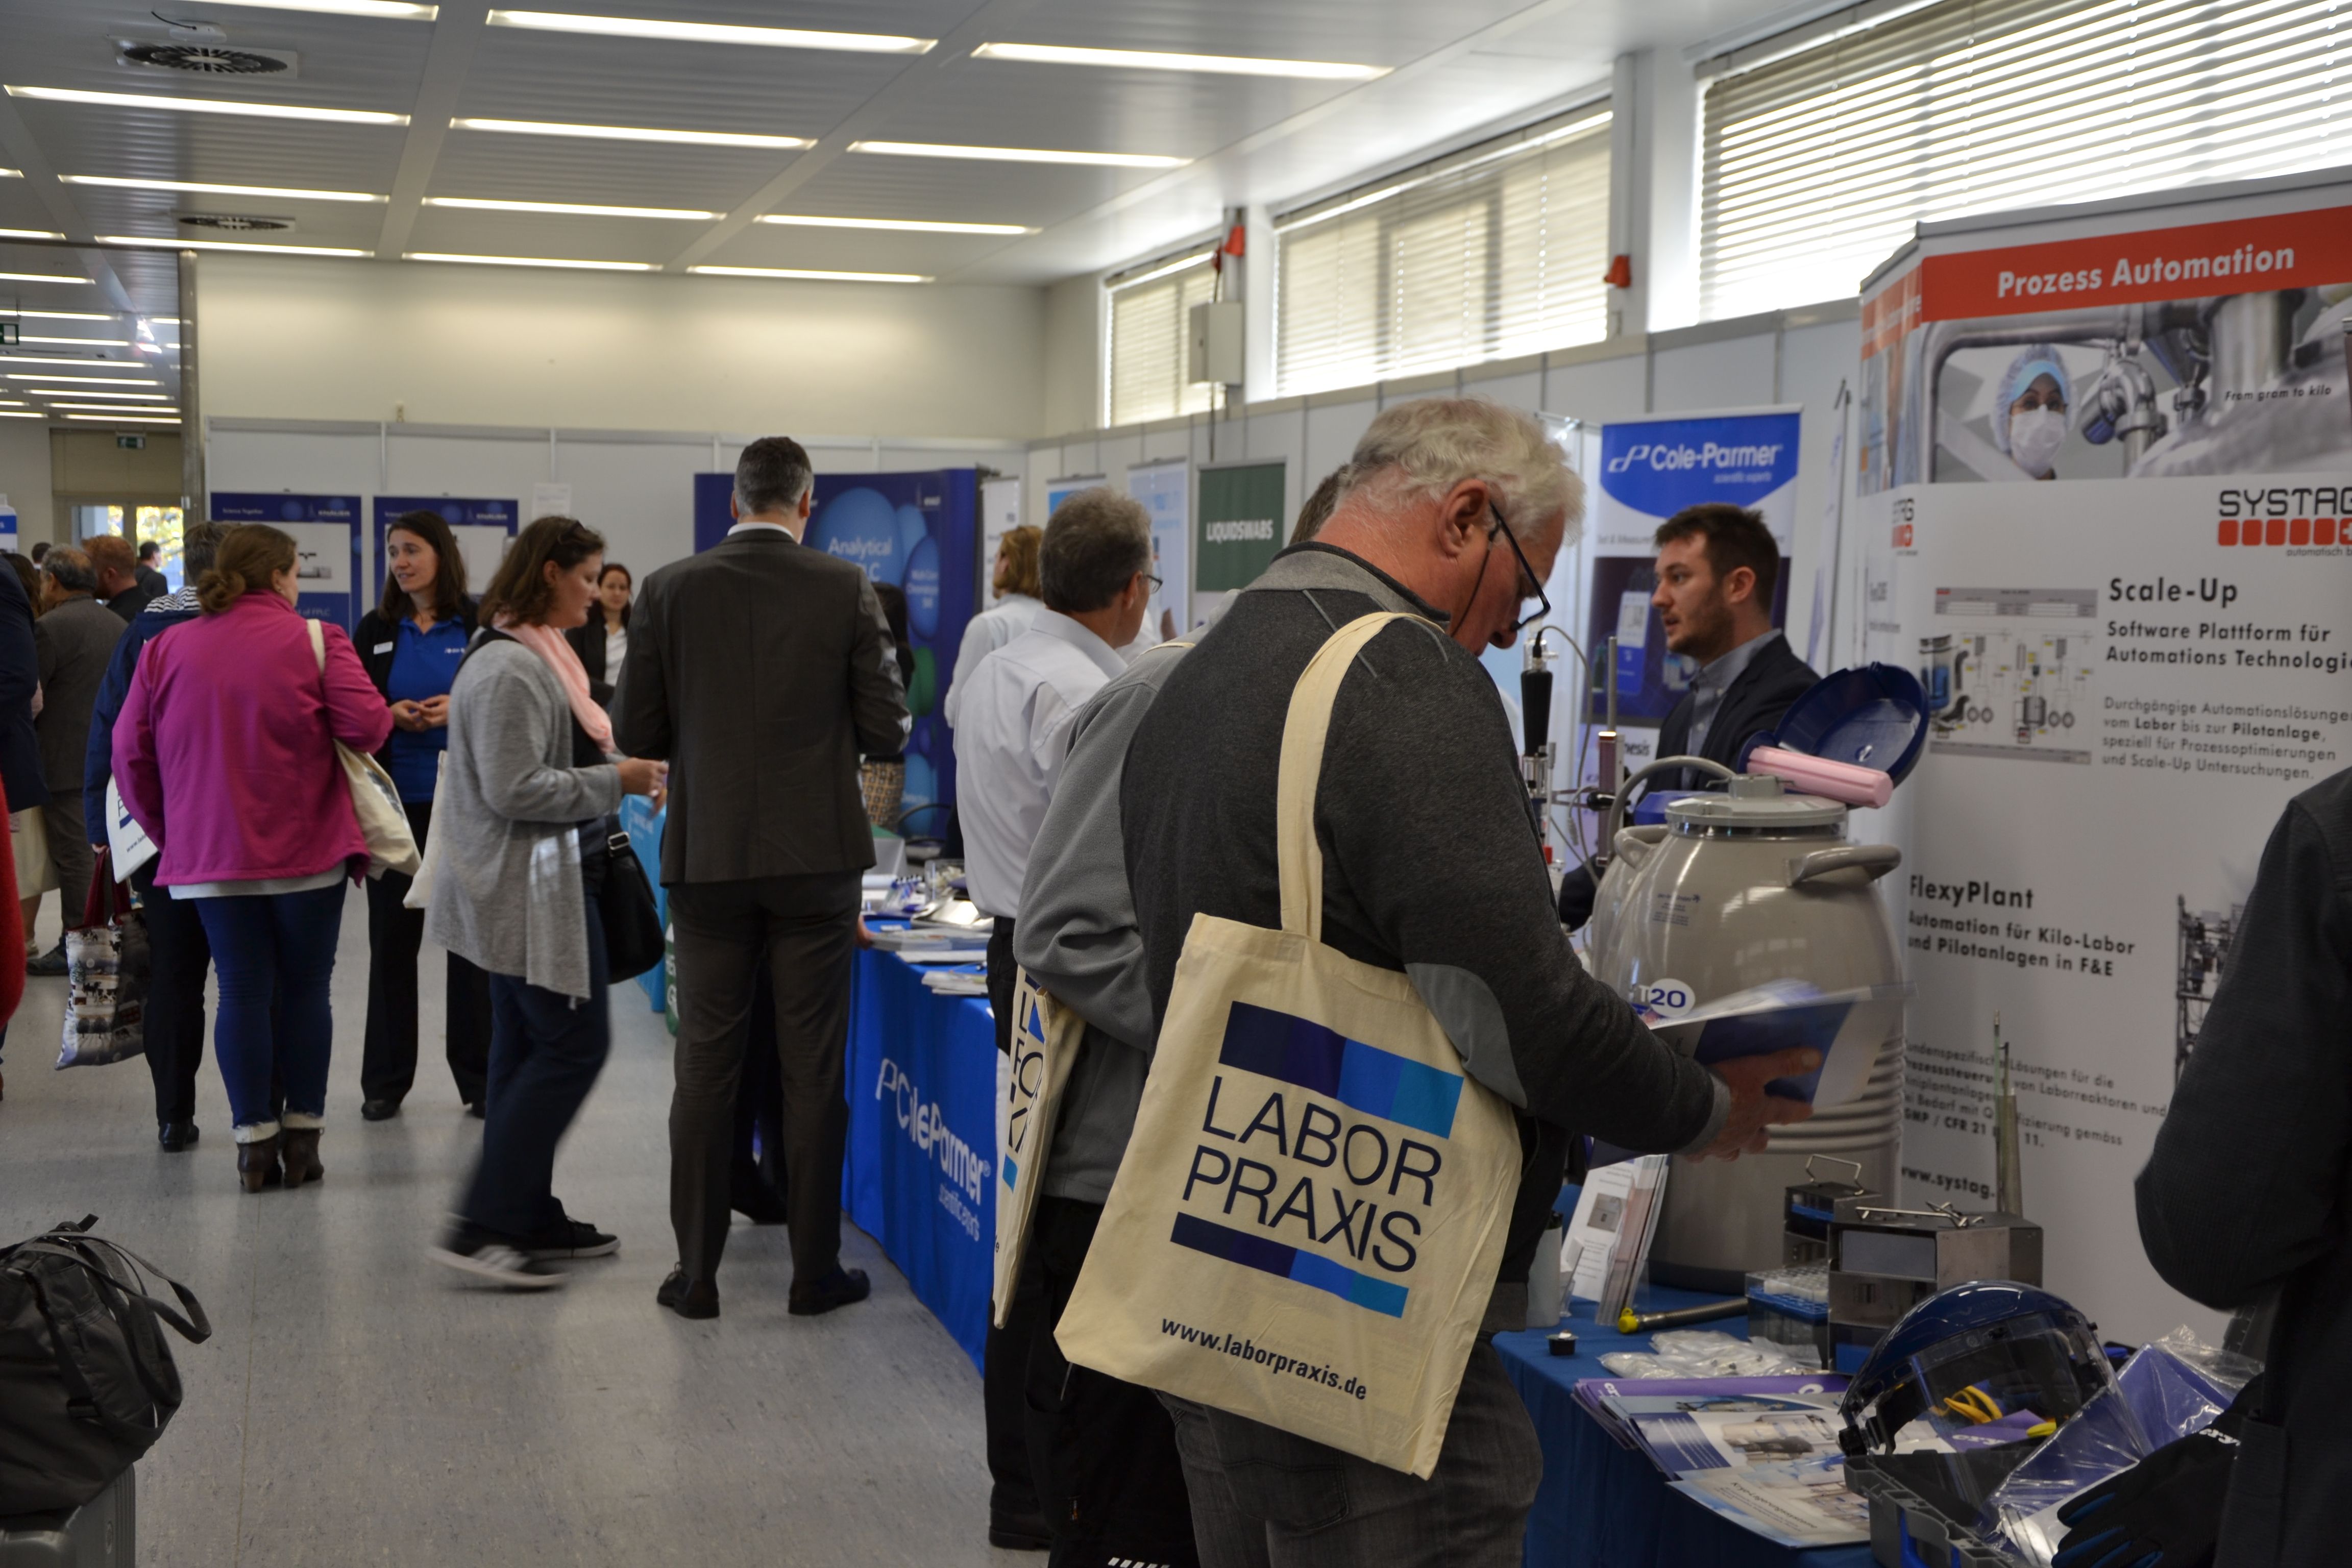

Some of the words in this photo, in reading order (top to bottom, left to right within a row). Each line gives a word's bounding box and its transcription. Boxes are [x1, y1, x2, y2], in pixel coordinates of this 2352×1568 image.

[1998, 268, 2102, 298] Prozess
[2111, 244, 2294, 287] Automation
[2225, 391, 2253, 401] From
[2258, 390, 2289, 401] gram
[2293, 388, 2304, 397] to
[2309, 385, 2332, 396] kilo
[1650, 442, 1778, 471] Cole-Parmer
[827, 536, 892, 560] Analytical
[2287, 547, 2342, 557] automatisch
[2109, 577, 2238, 609] Scale-Up
[2107, 620, 2191, 638] Software
[2199, 622, 2292, 641] Plattform
[2300, 624, 2331, 642] für
[2106, 646, 2227, 665] Automations
[2236, 650, 2352, 673] Technologi
[2104, 696, 2196, 716] Durchgängige
[2103, 718, 2129, 728] vom
[2135, 717, 2176, 731] Labor
[2182, 721, 2200, 733] bis
[2206, 724, 2227, 734] zur
[2232, 722, 2326, 743] Pilotanlage,
[2102, 735, 2152, 749] speziell
[2157, 737, 2175, 750] für
[2180, 738, 2336, 763] Prozessoptimierungen
[2102, 753, 2126, 766] und
[2131, 754, 2191, 771] Scale-Up
[2197, 759, 2314, 781] Untersuchungen.
[1910, 874, 2033, 909] FlexyPlant
[2006, 922, 2031, 940] für
[2038, 927, 2136, 955] Kilo-Labor
[1908, 935, 1931, 951] und
[1937, 938, 2048, 968] Pilotanlagen
[2056, 953, 2072, 970] in
[2080, 958, 2113, 976] F&E
[2071, 1069, 2090, 1083] für
[2094, 1074, 2114, 1089] die
[2014, 1080, 2036, 1092] von
[2040, 1083, 2138, 1112] Laborreaktoren
[2142, 1104, 2167, 1117] und
[1202, 1075, 1442, 1207] LABOR
[1972, 1121, 1987, 1135] 21
[2075, 1127, 2122, 1145] gemäss
[1182, 1144, 1422, 1272] PRAXIS
[1161, 1317, 1367, 1400] www.laborpraxis.de
